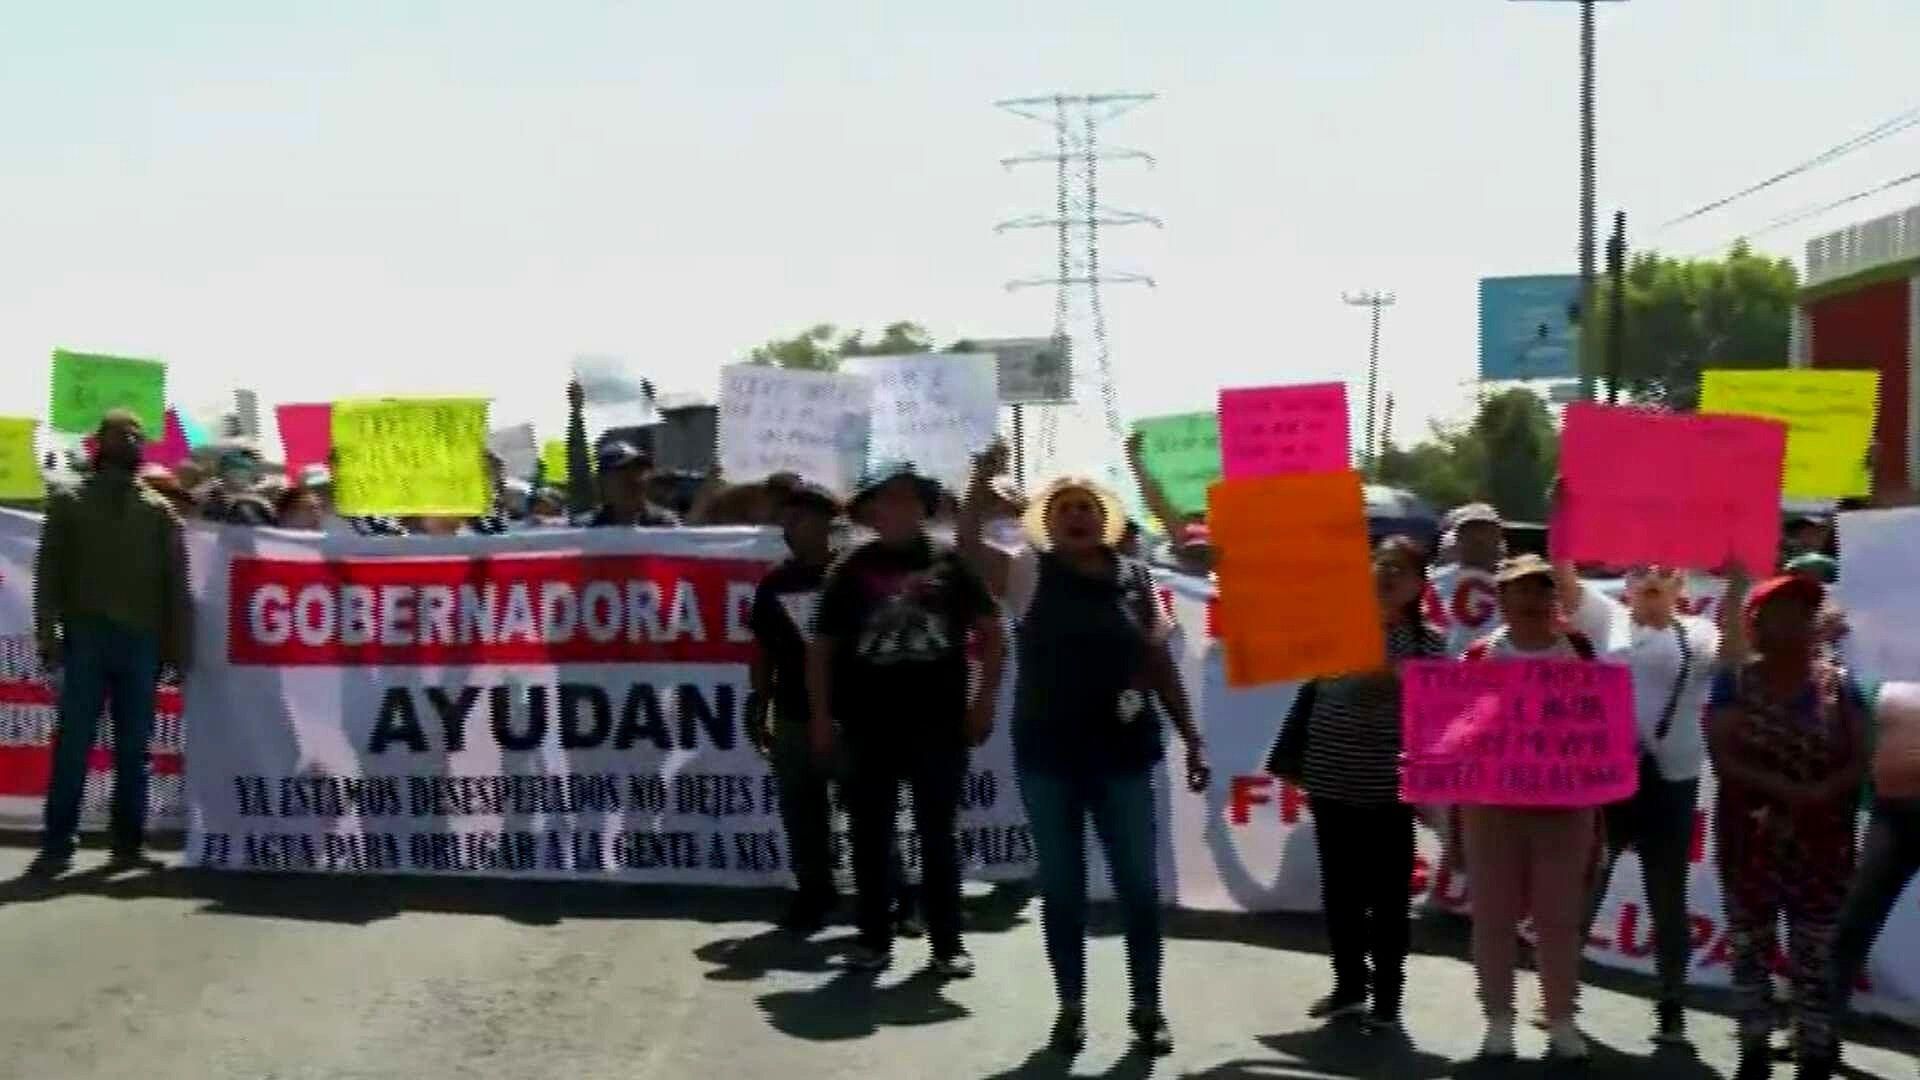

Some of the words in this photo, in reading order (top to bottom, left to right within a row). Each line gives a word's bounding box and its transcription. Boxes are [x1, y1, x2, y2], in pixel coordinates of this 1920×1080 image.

[251, 580, 706, 647] GOBERNADORA
[235, 775, 274, 818] YA
[280, 774, 402, 818] ESTAMOS
[411, 774, 620, 817] DESESPERADOS
[629, 774, 667, 816] NO
[677, 774, 755, 819] DEJES
[244, 832, 316, 869] AGUA
[325, 832, 400, 872] PARA
[409, 832, 537, 871] OBLIGAR
[571, 831, 604, 870] LA
[614, 831, 702, 871] GENTE
[734, 831, 782, 871] SUS
